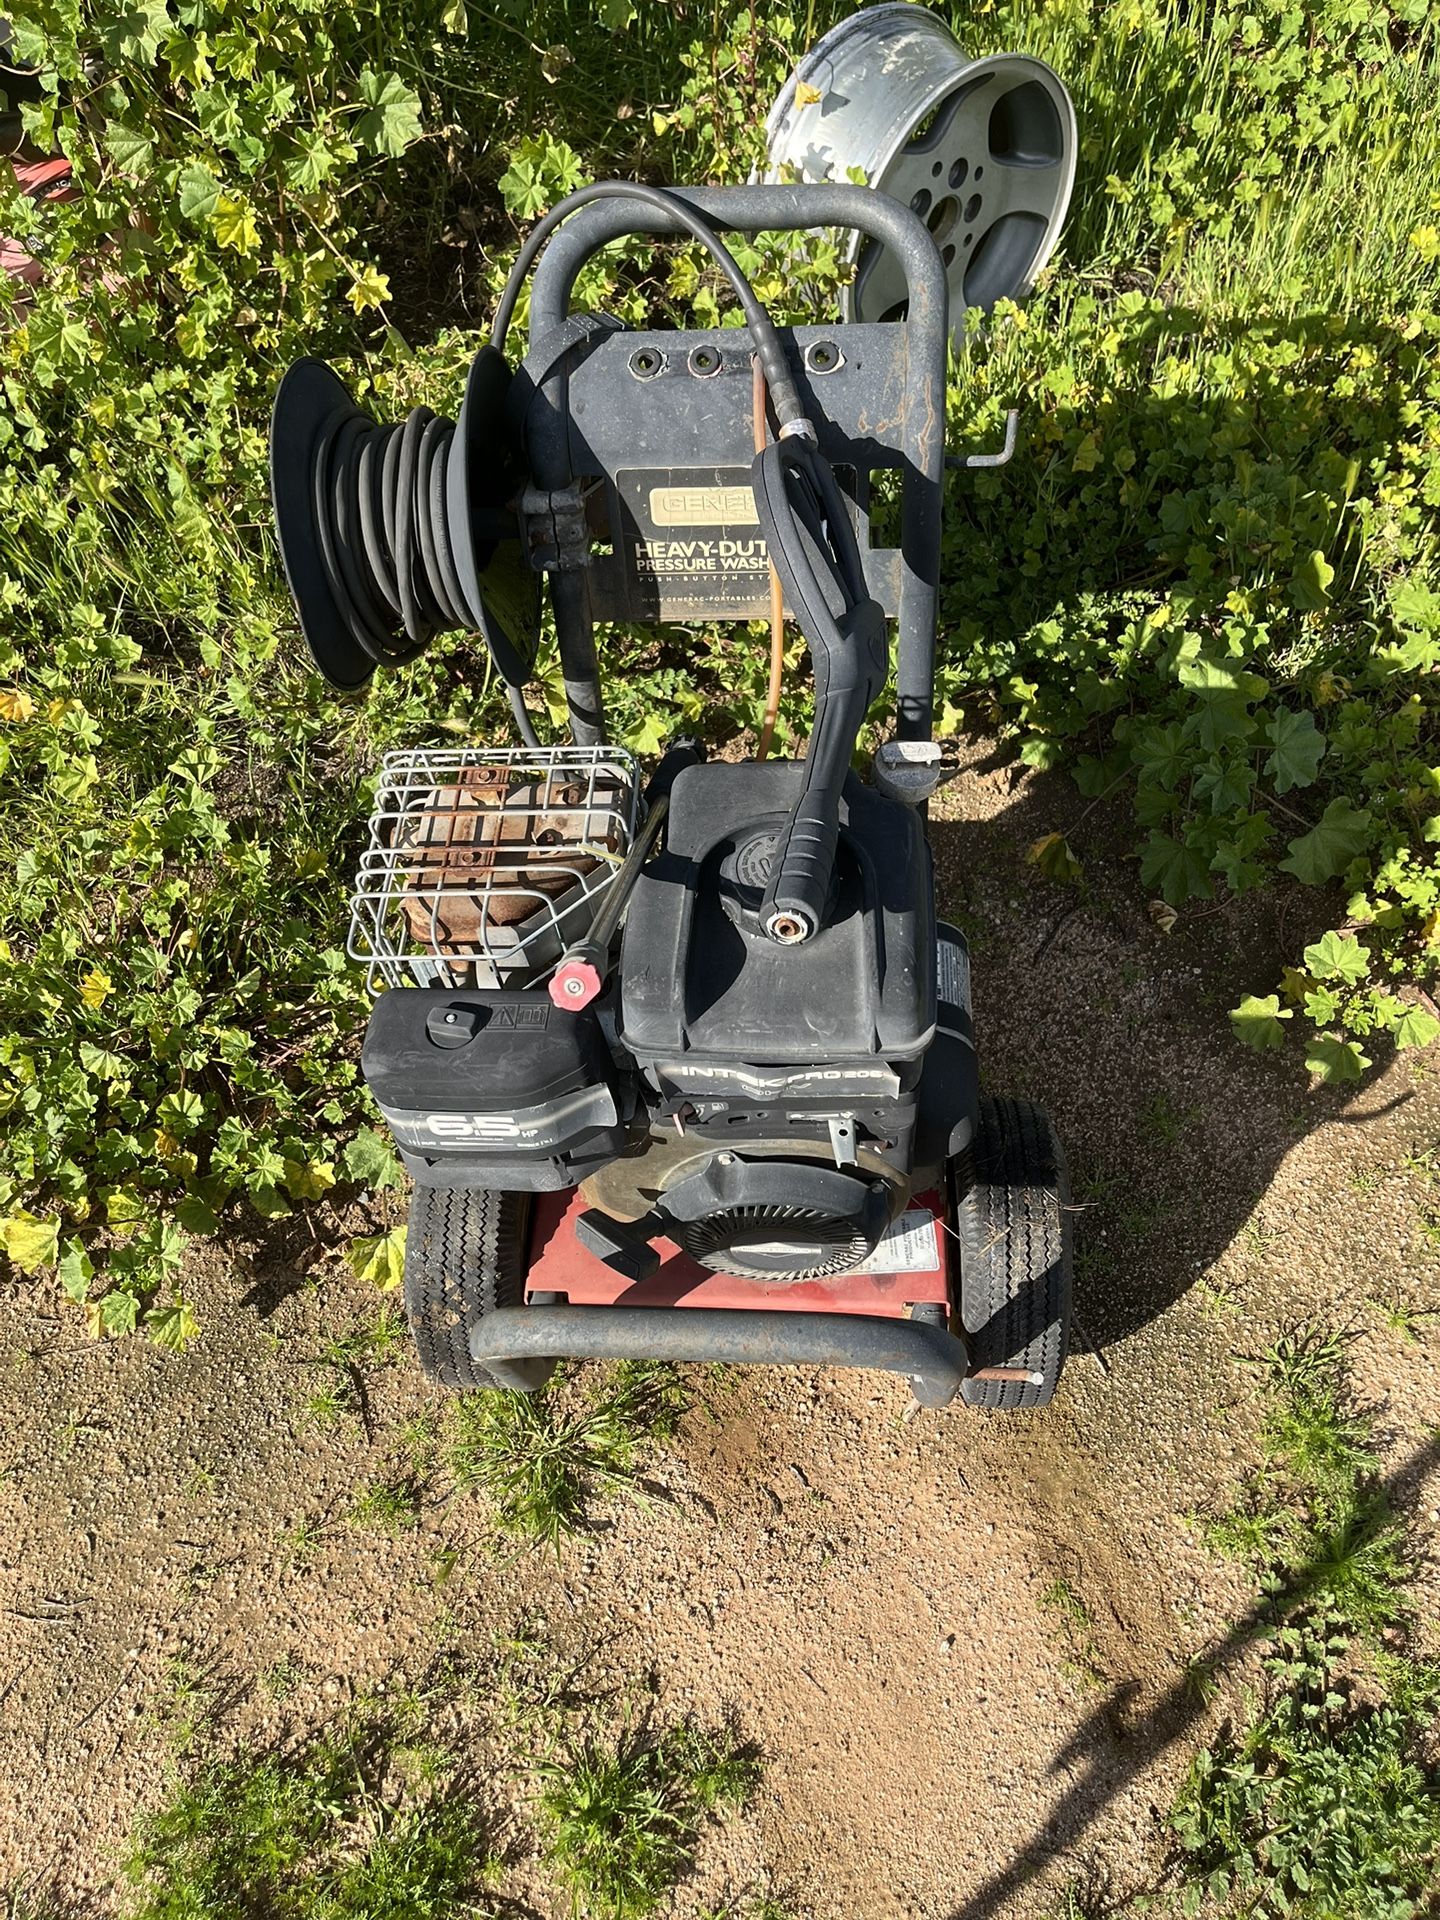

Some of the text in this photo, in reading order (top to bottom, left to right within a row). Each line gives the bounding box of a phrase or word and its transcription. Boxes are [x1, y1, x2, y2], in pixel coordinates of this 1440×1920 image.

[661, 493, 758, 513] GENER
[635, 540, 767, 557] HEAVY-DUT
[636, 557, 770, 571] PRESSURE WASH
[638, 574, 738, 583] PUSH-BUTTON
[641, 594, 771, 603] WWW.GENERAC-PORTABLES.CO
[681, 1066, 786, 1087] INTEK
[426, 1114, 539, 1139] 6.5 HP
